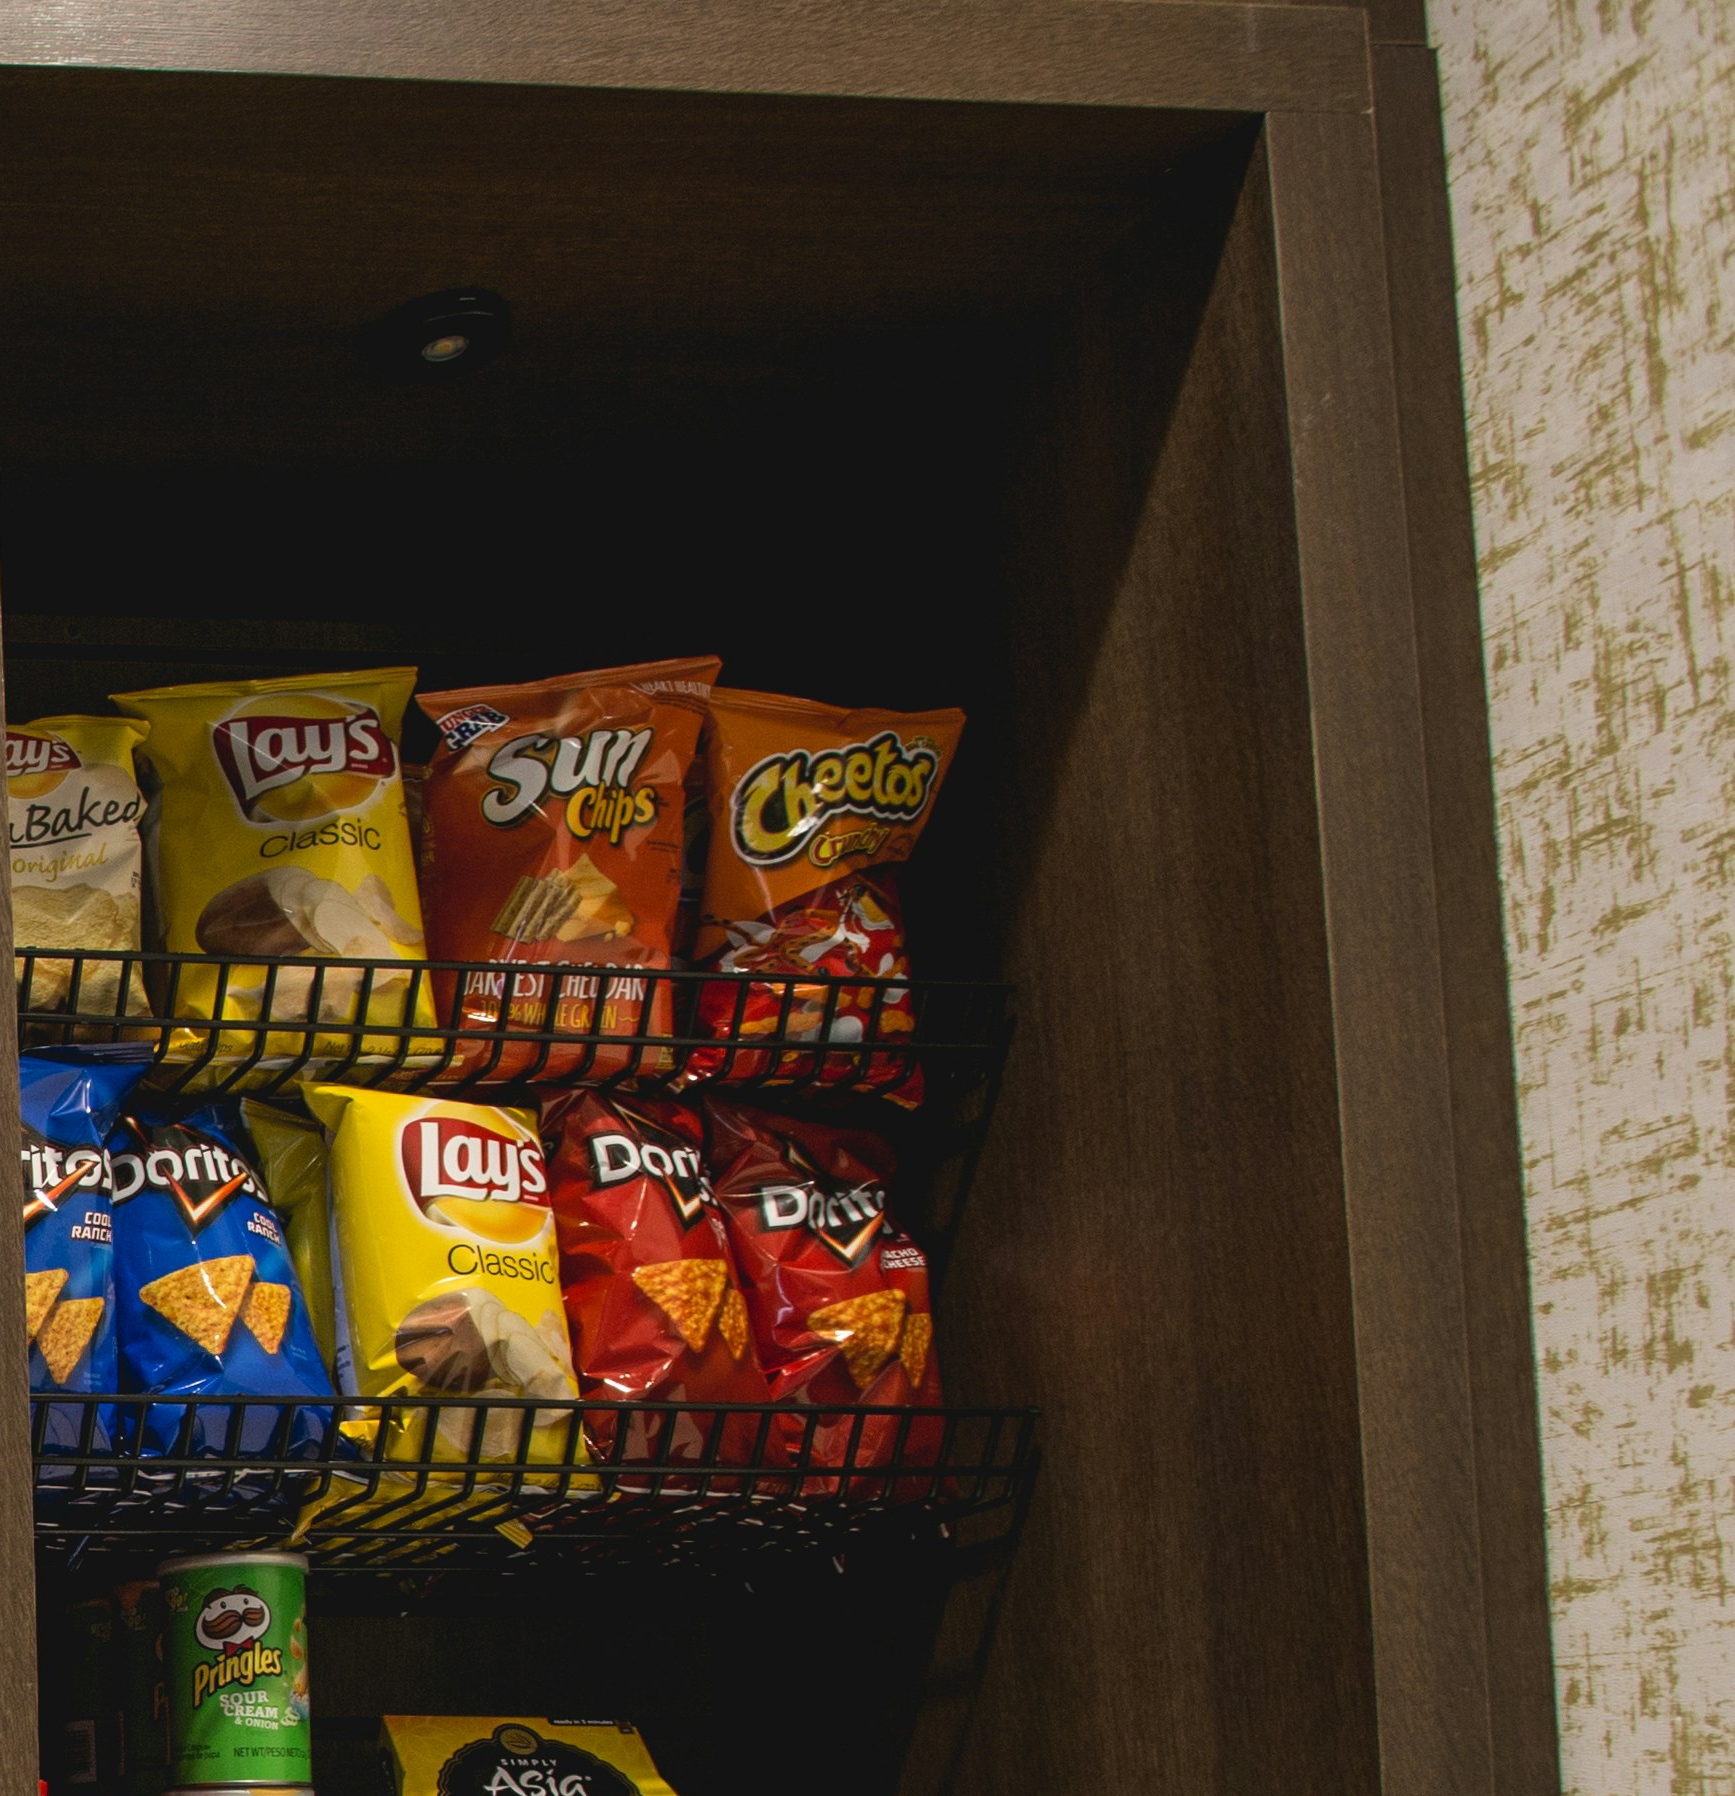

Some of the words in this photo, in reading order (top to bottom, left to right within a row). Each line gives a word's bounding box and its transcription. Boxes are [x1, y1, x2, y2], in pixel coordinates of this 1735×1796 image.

[228, 714, 381, 801] Lay's
[482, 726, 654, 825] Sun
[25, 787, 140, 842] Baked
[565, 781, 656, 844] Chips
[737, 735, 933, 857] Cheetos
[260, 818, 381, 858] Classic
[419, 1120, 547, 1204] Lay's
[447, 1243, 554, 1285] Classic
[193, 1641, 282, 1710] Pringles
[219, 1690, 270, 1708] SOUR
[224, 1705, 279, 1720] CREAM
[245, 1717, 279, 1730] ONION
[500, 1758, 558, 1768] SIMPLY
